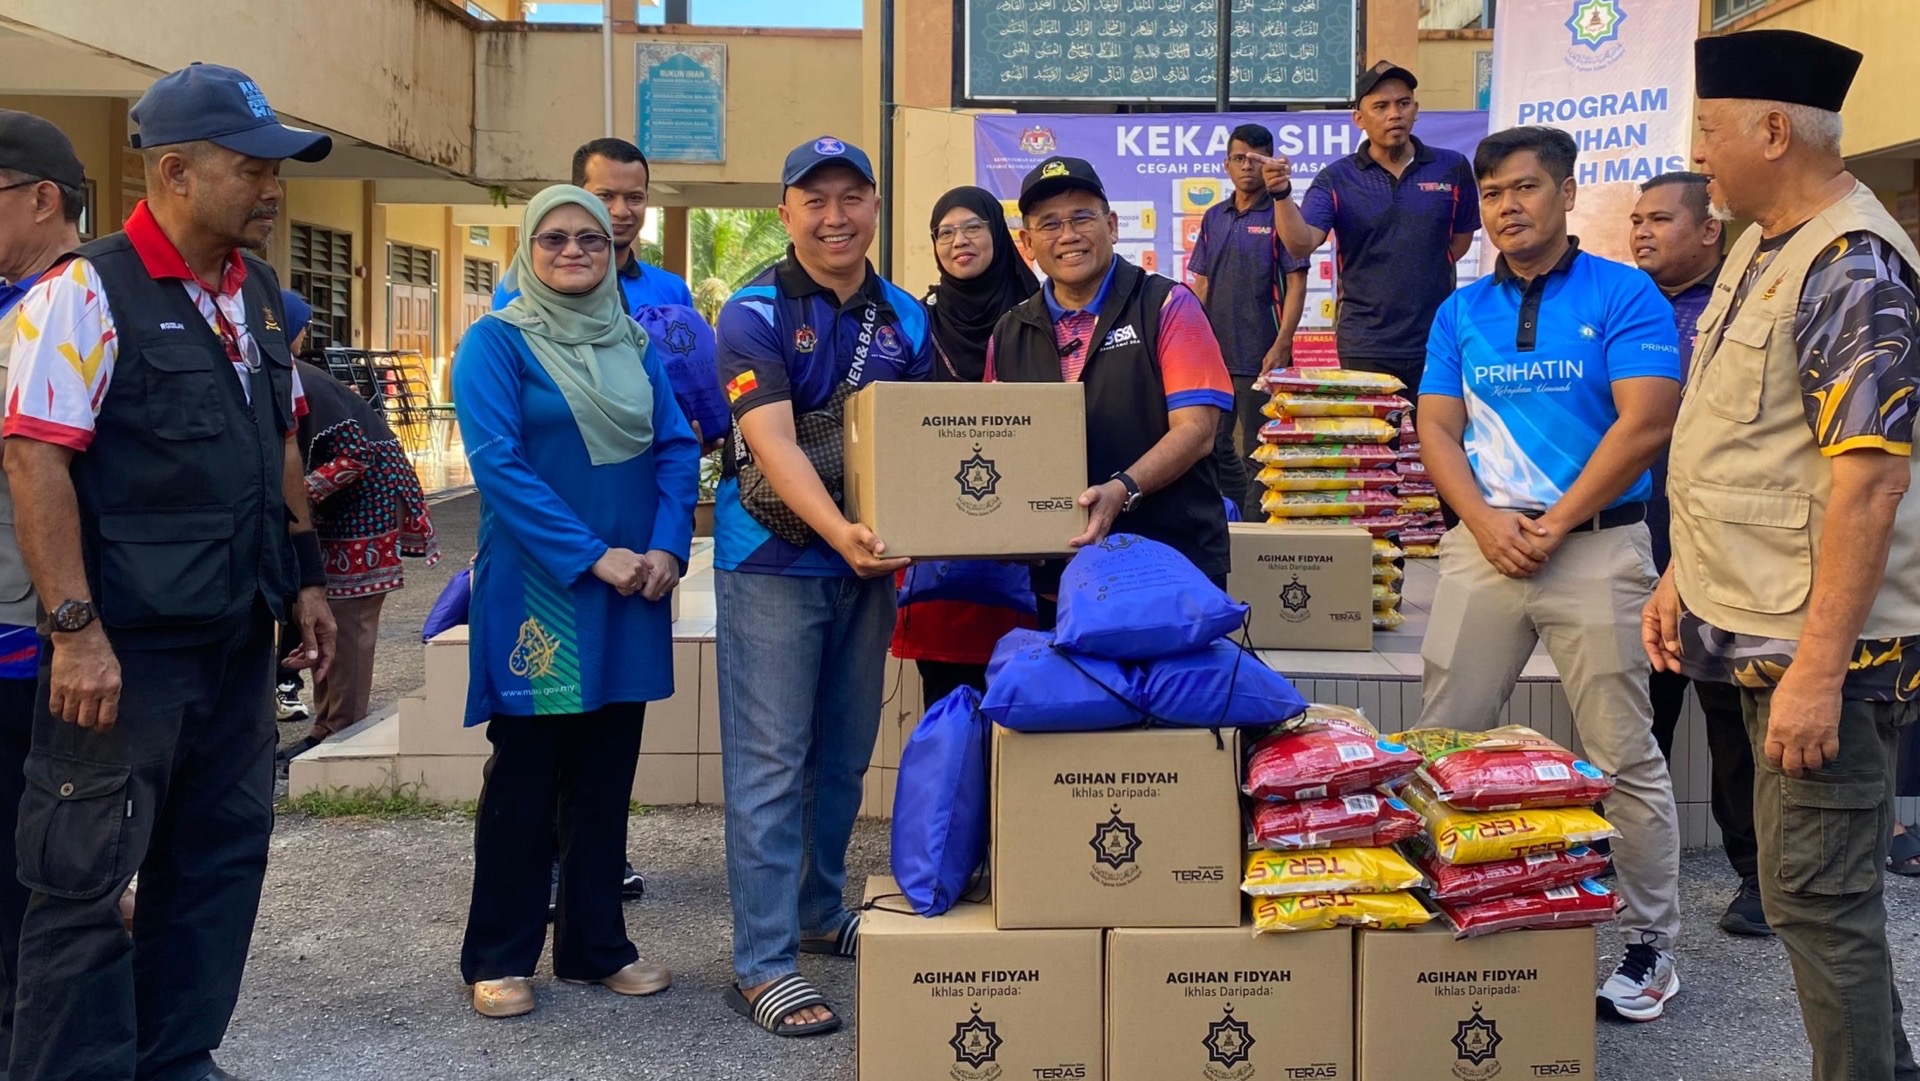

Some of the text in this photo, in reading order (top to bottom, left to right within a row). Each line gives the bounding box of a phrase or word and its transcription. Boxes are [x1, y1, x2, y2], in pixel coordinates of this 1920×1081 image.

[660, 70, 705, 78] RUKUN IMAN
[1518, 88, 1668, 125] PROGRAM
[1116, 125, 1229, 157] KEKA
[1576, 123, 1647, 153] IHAN
[1136, 163, 1188, 174] CEGAH
[1291, 162, 1328, 173] MASA
[1604, 156, 1685, 182] MAIS
[1146, 214, 1151, 224] 1
[1146, 256, 1152, 265] 2
[1324, 266, 1330, 276] 6
[1325, 303, 1330, 313] 7
[1475, 360, 1584, 385] PRIHATIN
[922, 416, 1032, 427] AGIHAN FIDYAH
[938, 428, 1016, 439] Ikhlas Daripada:
[1028, 500, 1073, 511] TERAS
[1257, 554, 1333, 563] AGIHAN FIDYAH
[1329, 613, 1361, 621] TERAS
[1054, 772, 1178, 785] AGIHAN FIDYAH
[1072, 787, 1160, 799] Ikhlas Daripada:
[1440, 817, 1536, 847] TERAS
[1249, 857, 1346, 879] TERAS
[1171, 870, 1224, 881] TERAS
[1258, 894, 1356, 920] TERAS
[912, 970, 1039, 984] AGIHAN FIDYAH
[1166, 970, 1291, 984] AGIHAN FIDYAH
[1417, 969, 1537, 983] AGIHAN FIDYAH
[931, 986, 1021, 999] Ikhlas Daripada:
[1184, 986, 1273, 998] Ikhlas Daripada:
[1435, 985, 1520, 997] Ikhlas Daripada:
[1033, 1067, 1086, 1079] TERAS
[1285, 1066, 1337, 1078] TERAS
[1530, 1063, 1580, 1075] TERAS
